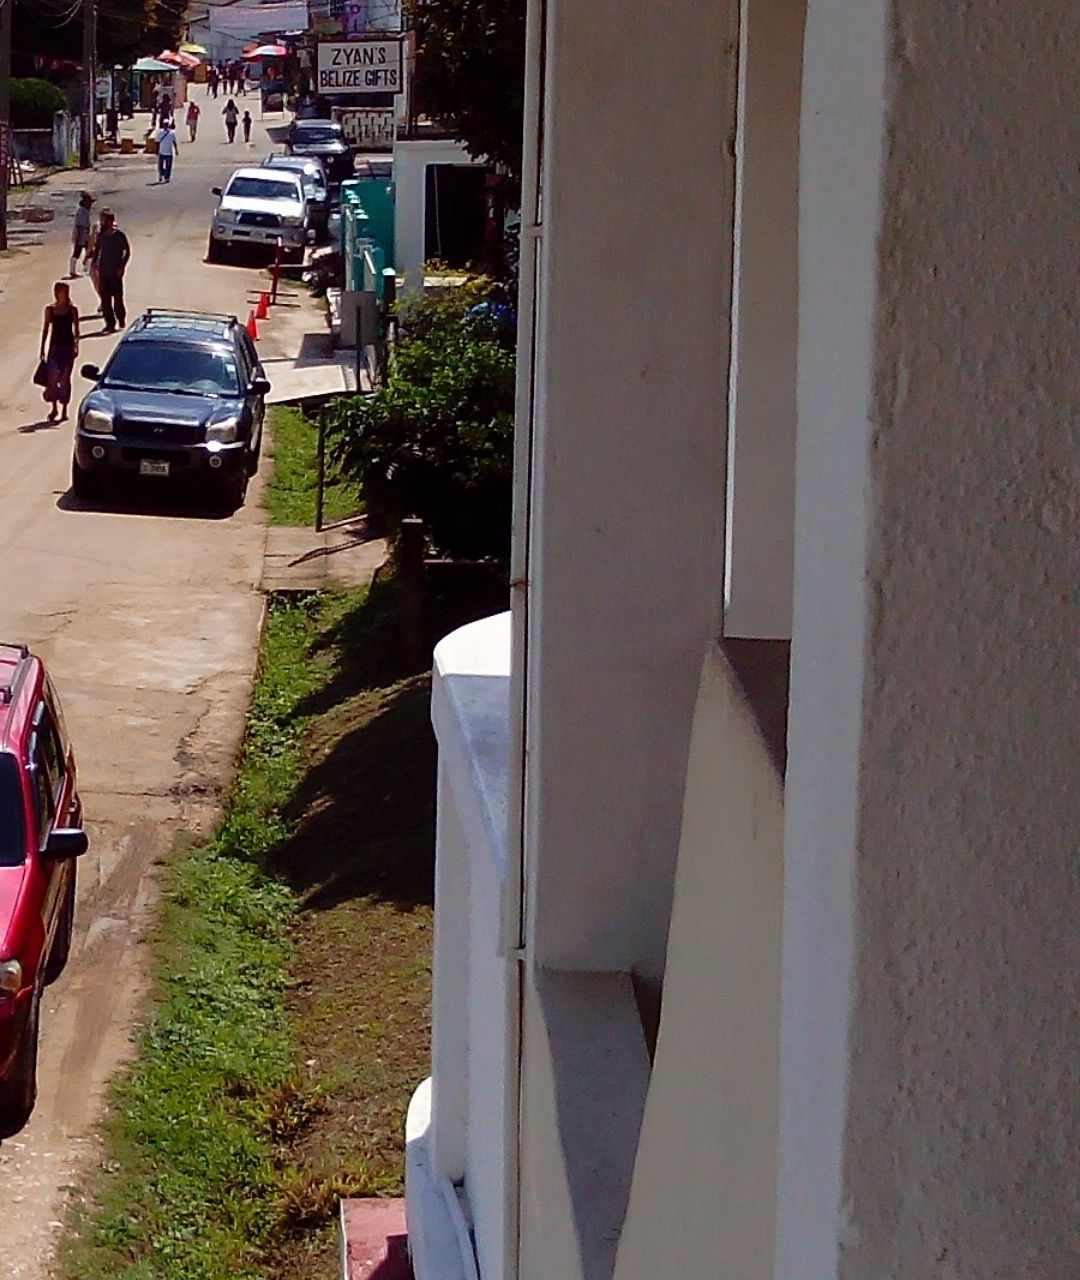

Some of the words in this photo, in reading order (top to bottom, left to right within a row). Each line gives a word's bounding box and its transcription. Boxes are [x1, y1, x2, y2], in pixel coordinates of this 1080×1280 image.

[331, 47, 386, 65] ZYAN'S
[320, 69, 361, 87] BELIZE
[365, 68, 397, 86] GIFTS
